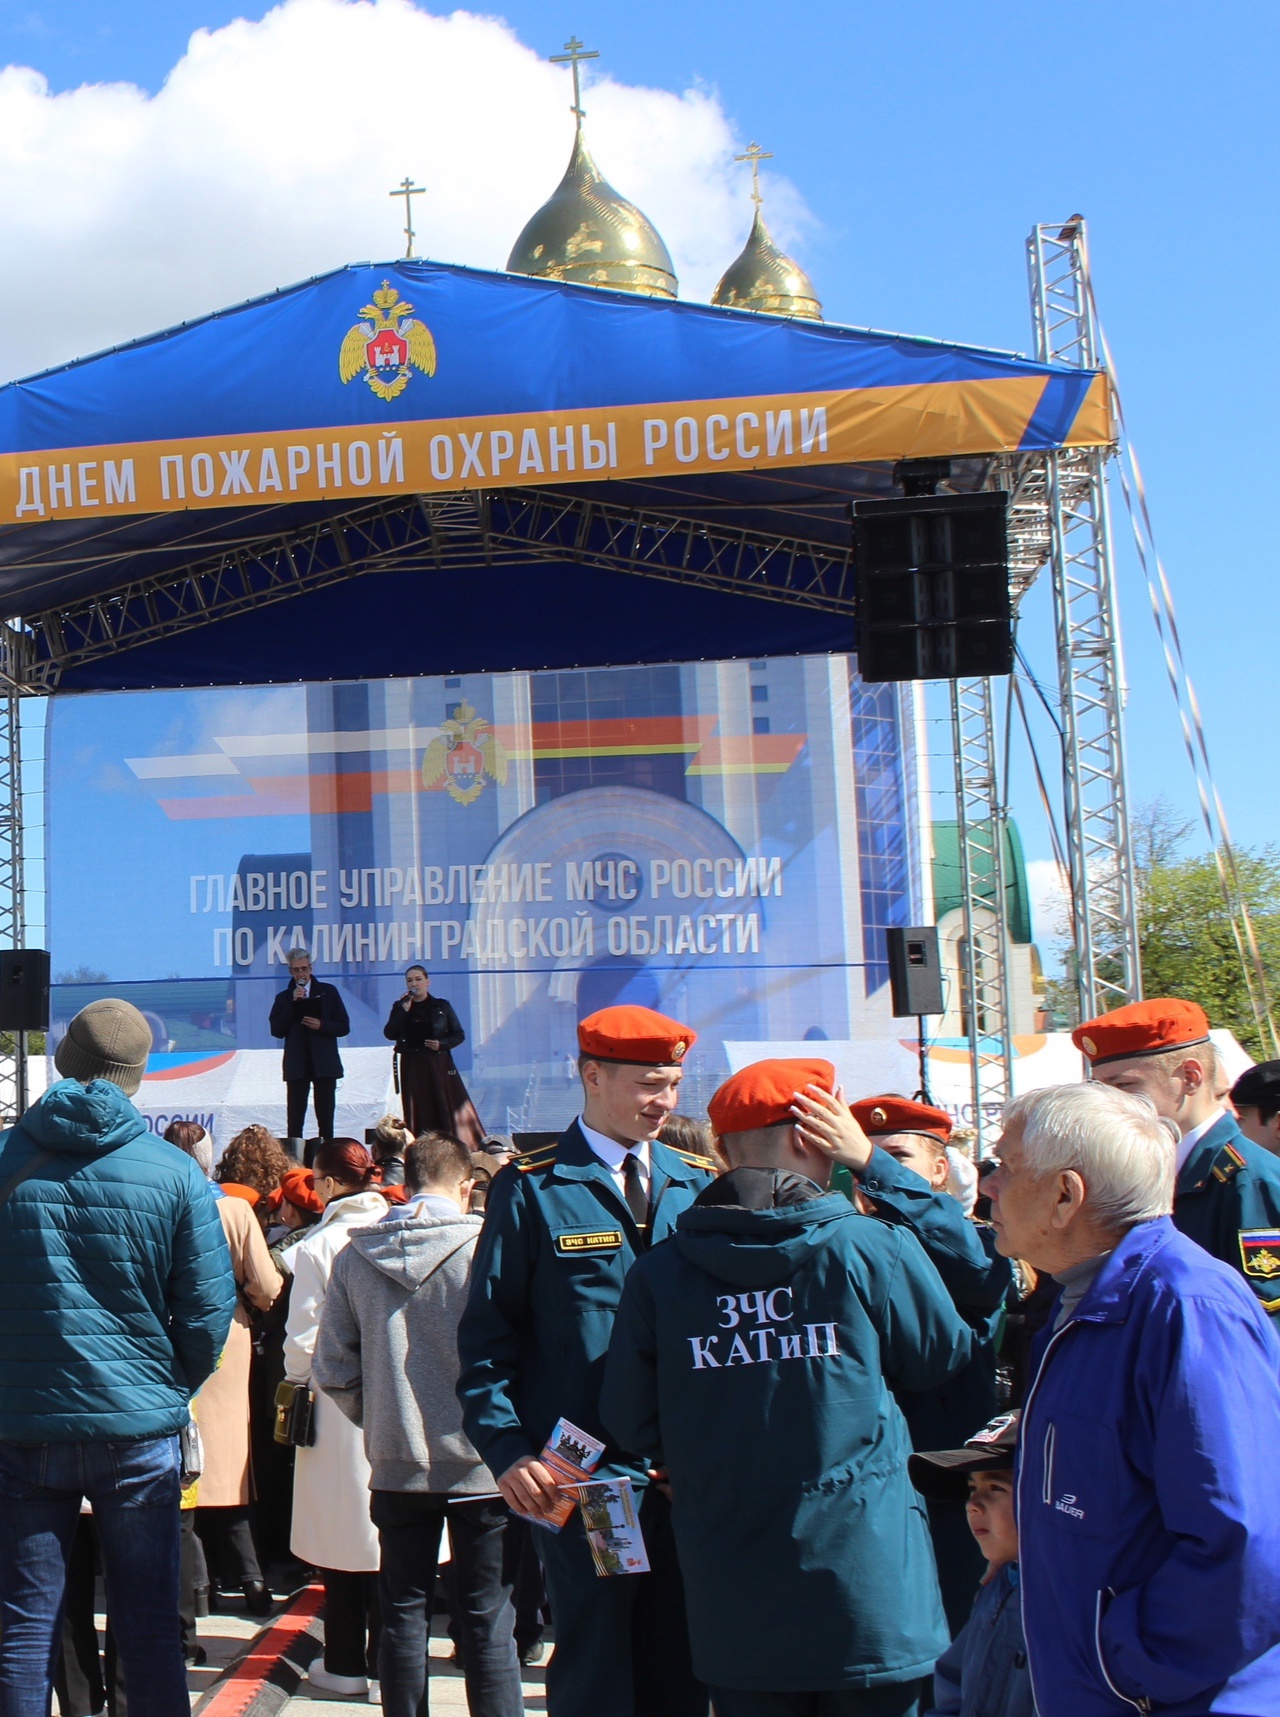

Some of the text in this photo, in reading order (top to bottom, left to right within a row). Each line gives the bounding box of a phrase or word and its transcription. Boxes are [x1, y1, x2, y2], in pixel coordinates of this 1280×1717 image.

[15, 458, 137, 518] ДНЕМ
[159, 430, 406, 501] ПОЖАРНОЙ
[429, 421, 619, 481] ОХРАНЫ
[642, 406, 830, 466] РОССИИ
[189, 856, 784, 914] ГЛАВНОЕ УПРАВЛЕНИЕ МЧС РОССИИ
[212, 909, 761, 967] ПО КАЛИНИНГРАДСКОЙ ОБЛАСТИ
[715, 1285, 795, 1330] ЗЧС
[686, 1321, 842, 1370] КАТиП
